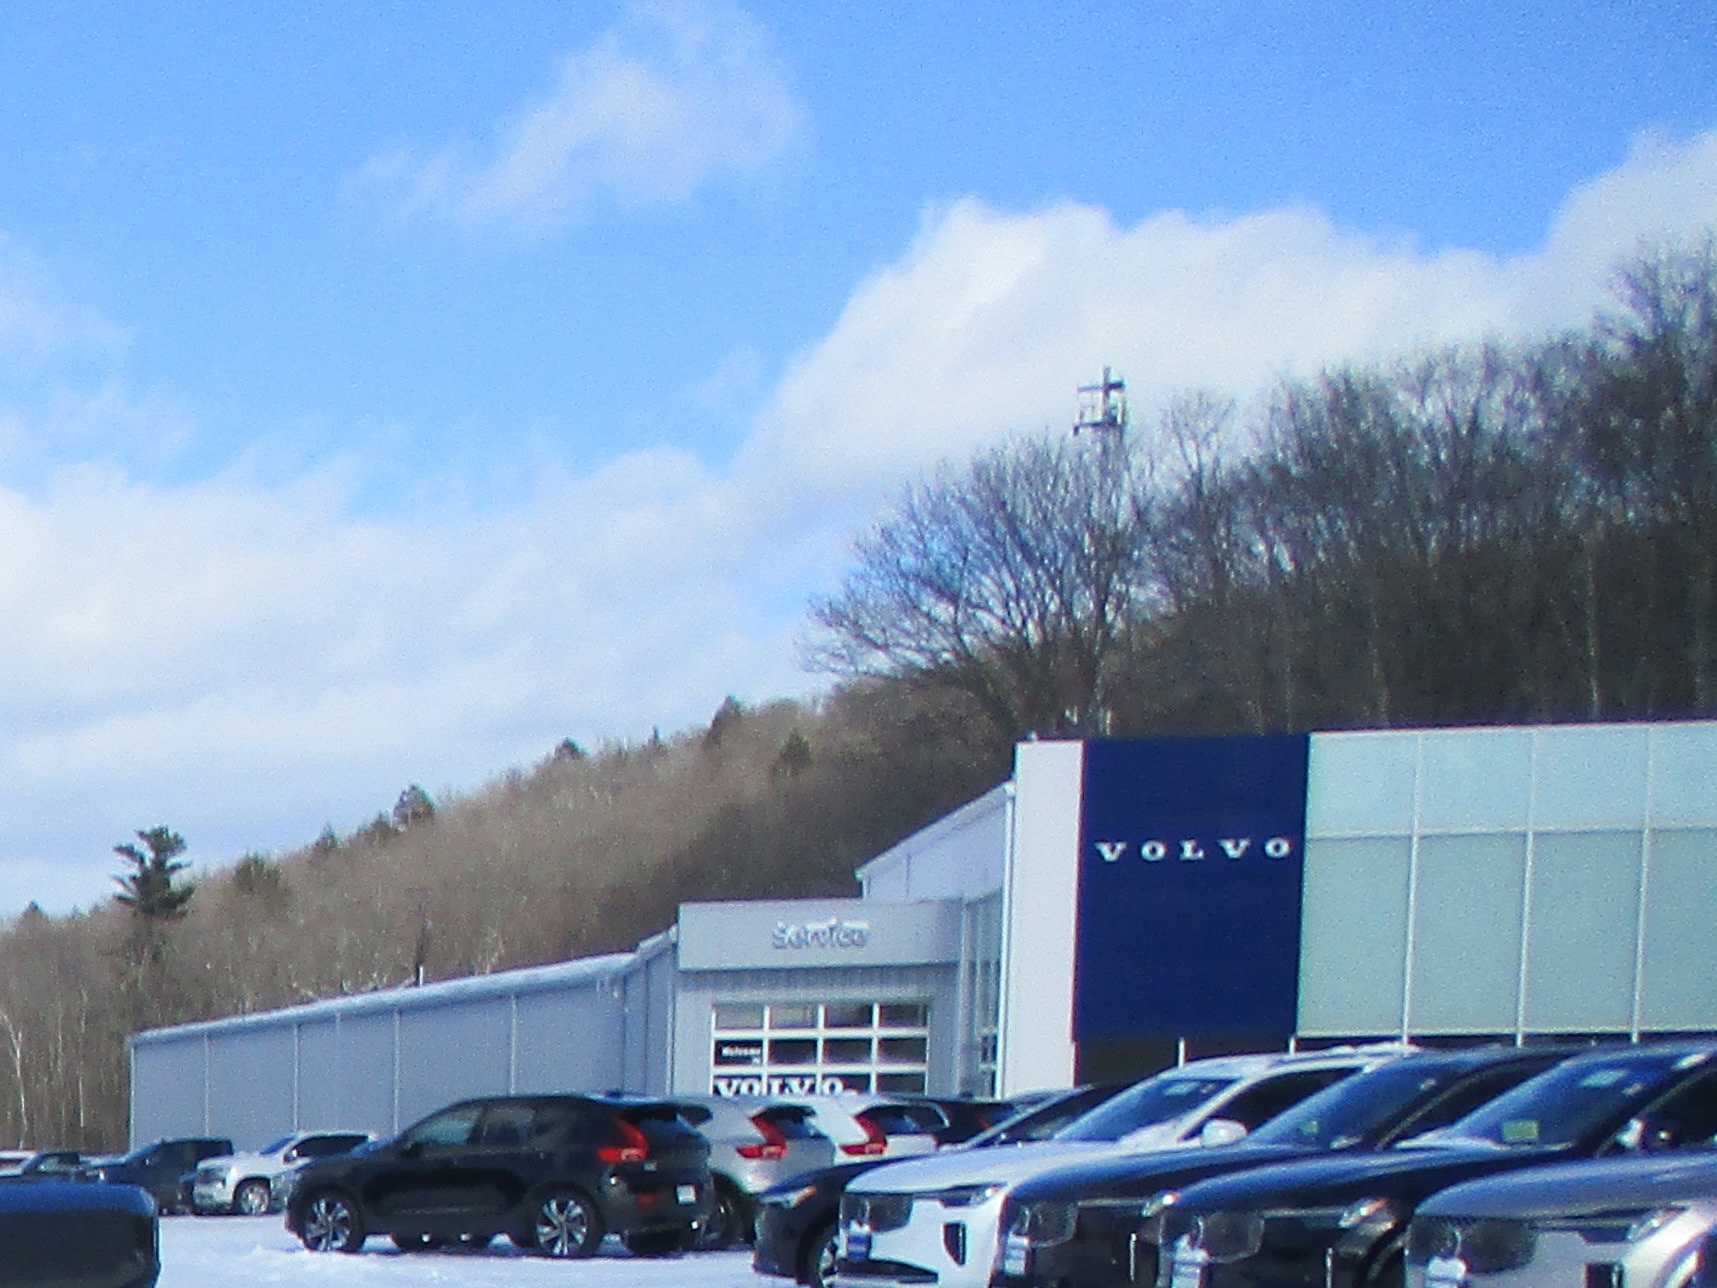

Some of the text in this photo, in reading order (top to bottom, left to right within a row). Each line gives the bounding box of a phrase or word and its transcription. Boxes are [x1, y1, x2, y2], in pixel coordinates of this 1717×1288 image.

[1094, 836, 1290, 862] VOLVO
[772, 917, 871, 949] Service
[715, 1077, 845, 1096] VOLVO
